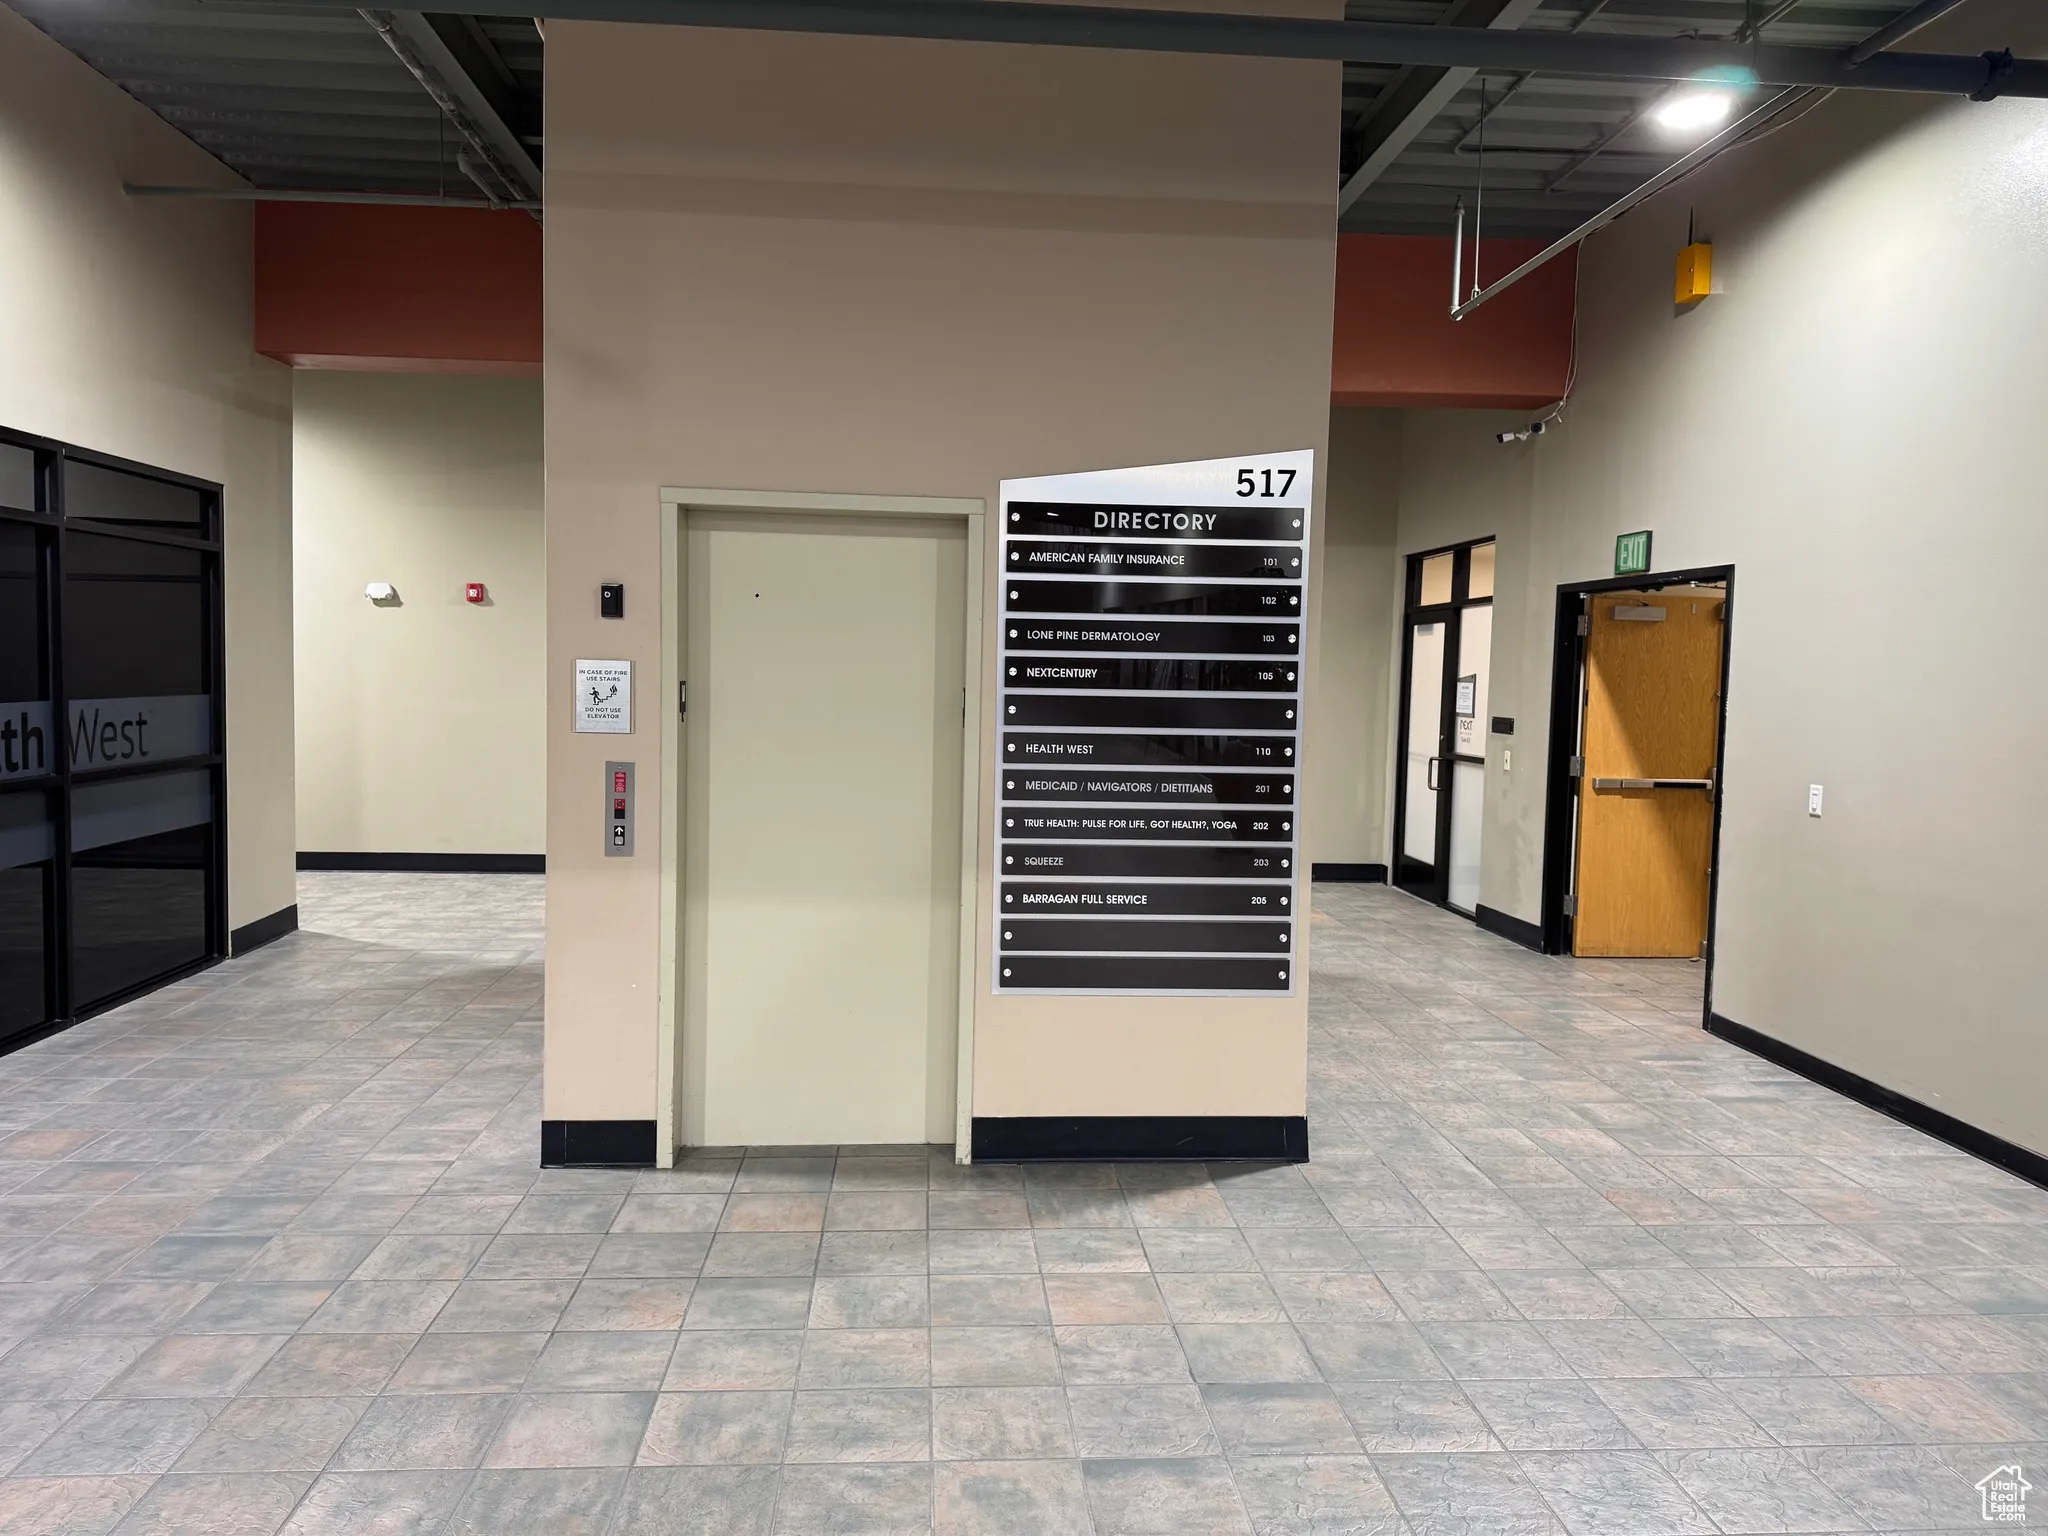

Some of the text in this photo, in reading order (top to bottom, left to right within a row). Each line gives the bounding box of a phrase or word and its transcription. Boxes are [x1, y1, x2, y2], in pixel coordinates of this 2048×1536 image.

[1236, 469, 1296, 497] 517
[1094, 511, 1217, 531] DIRECTORY
[1028, 552, 1278, 566] AMERICAN FAMILY INSURANCE 101
[1620, 536, 1647, 570] EXIT
[1261, 597, 1277, 605] 102
[1027, 631, 1275, 643] LONE PINE DERMATOLOGY 103
[1026, 668, 1274, 681] NEXTCENTURY 105
[0, 708, 148, 773] th West
[1025, 744, 1271, 756] HEALTH WEST 110
[1025, 781, 1078, 791] MEDICAID
[1087, 782, 1152, 793] NAVIGATORS
[1161, 784, 1213, 794] DIETITIANS
[1255, 785, 1270, 793] 201
[1023, 819, 1269, 831] TRUE HEALTH: PULSE FOR LIFE, GOT HEALTH?, YOGA 202
[1024, 857, 1270, 867] SQUEEZE 203
[1022, 894, 1267, 905] BARRAGAN FULL SERVICE 205
